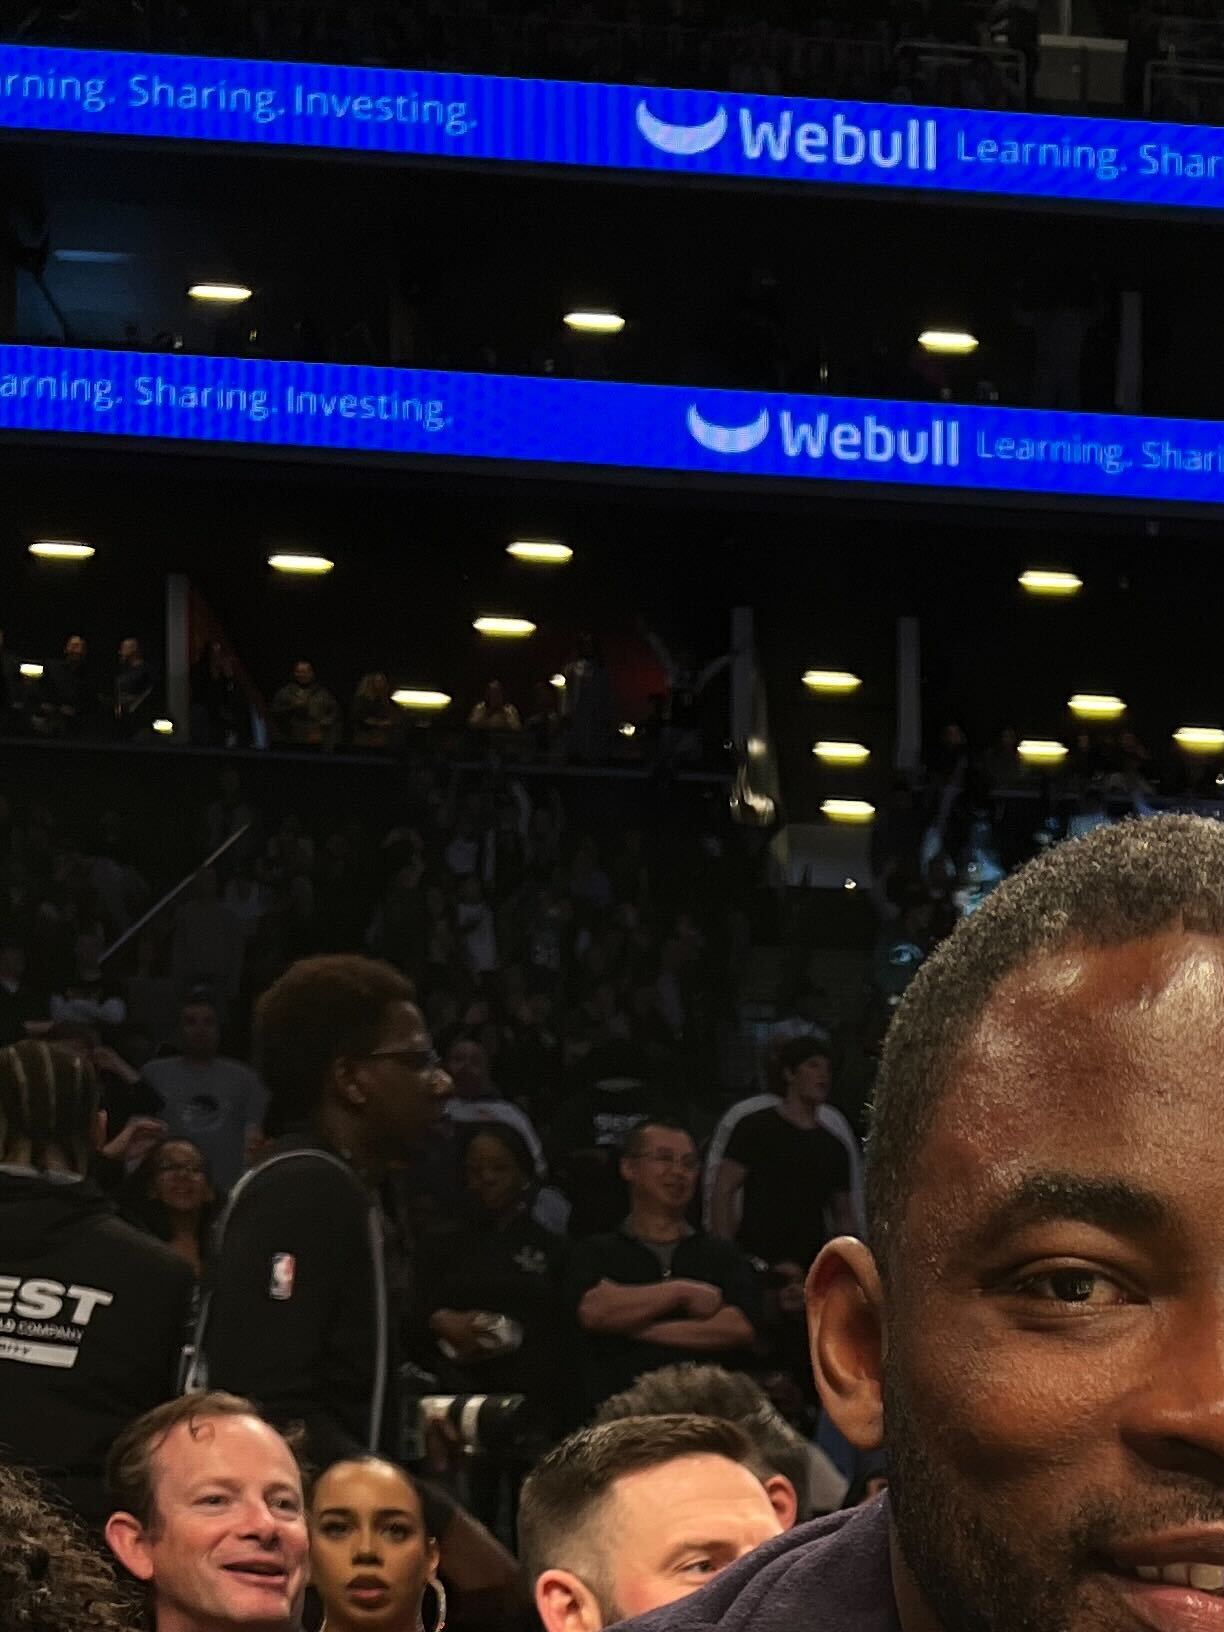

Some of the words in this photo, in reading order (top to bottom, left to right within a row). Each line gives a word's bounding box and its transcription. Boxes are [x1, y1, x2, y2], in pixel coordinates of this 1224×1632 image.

[0, 69, 116, 113] rning.
[127, 74, 285, 124] Sharing.
[294, 84, 478, 136] Investing.
[738, 107, 938, 172] Webull
[957, 130, 1128, 180] Learning.
[135, 376, 279, 421] Sharing.
[287, 386, 453, 431] Investing.
[780, 409, 959, 467] Webull
[976, 428, 1132, 474] Learning.
